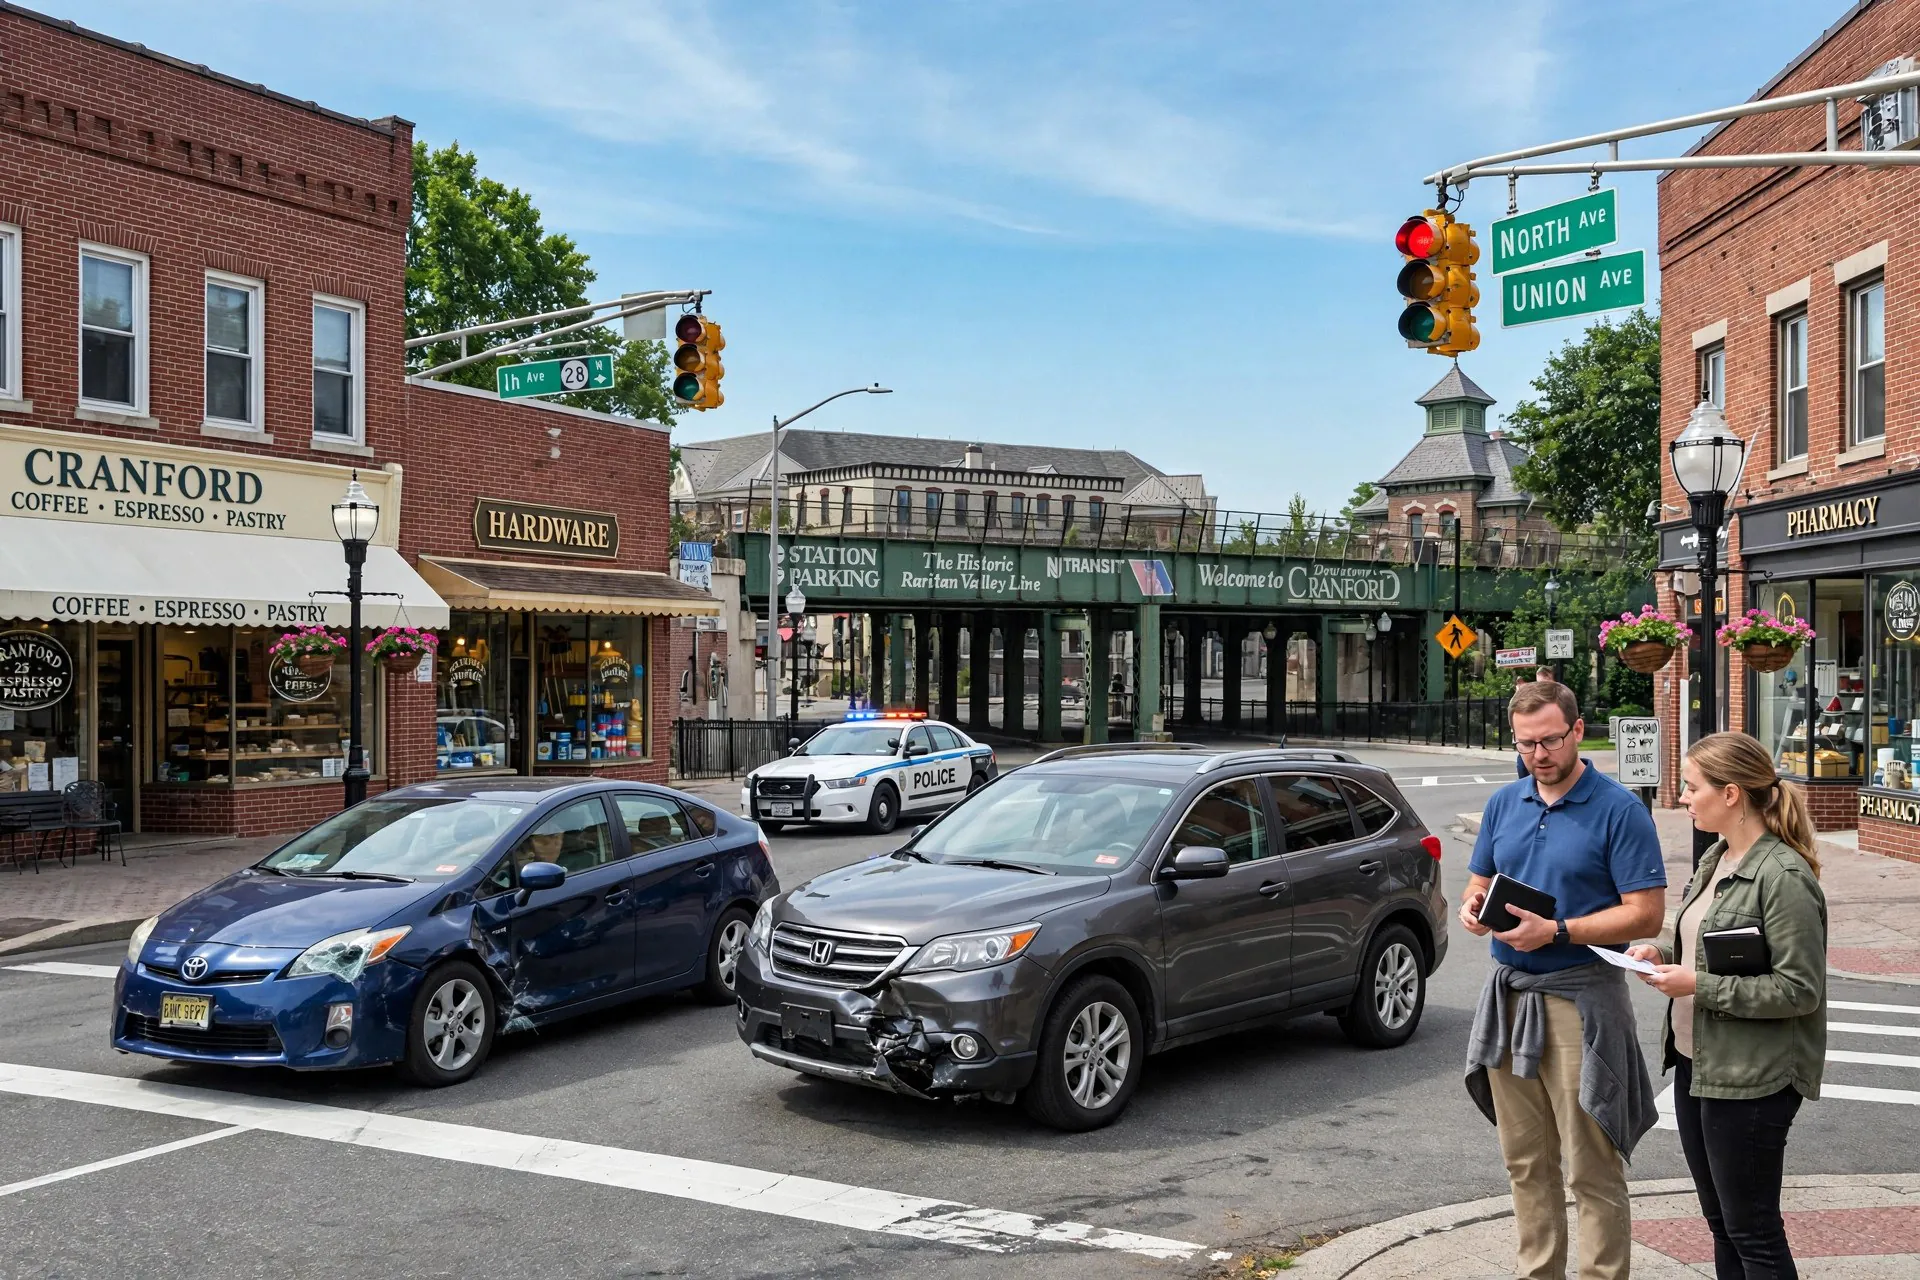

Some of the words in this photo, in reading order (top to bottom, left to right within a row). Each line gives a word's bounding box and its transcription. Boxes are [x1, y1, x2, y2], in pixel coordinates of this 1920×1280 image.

[1501, 217, 1570, 259] NORTH
[1578, 208, 1606, 229] Ave
[1513, 276, 1586, 312] UNION
[1600, 268, 1632, 289] Ave
[526, 372, 545, 383] Ave
[564, 366, 585, 384] 28
[25, 447, 263, 505] CRANFORD
[11, 491, 89, 515] COFFEE
[114, 500, 205, 524] ESPRESSO
[226, 510, 287, 531] PASTRY
[1787, 496, 1878, 536] PHARMACY
[489, 510, 610, 549] HARDWARE
[789, 545, 877, 566] STATION
[922, 552, 953, 570] The
[956, 553, 1014, 571] Historic
[1063, 557, 1125, 574] TRANSIT
[790, 568, 880, 588] PARKING
[901, 571, 958, 589] Raritan
[961, 573, 1007, 593] Valley
[1009, 575, 1041, 591] Line
[1198, 563, 1266, 588] Welcome
[1268, 571, 1284, 589] to
[1288, 566, 1401, 601] CRANFORD
[52, 596, 130, 616] COFFEE
[154, 599, 246, 621] ESPRESSO
[267, 604, 328, 623] PASTRY
[914, 768, 955, 789] POLICE
[1860, 795, 1920, 825] PHARMACY
